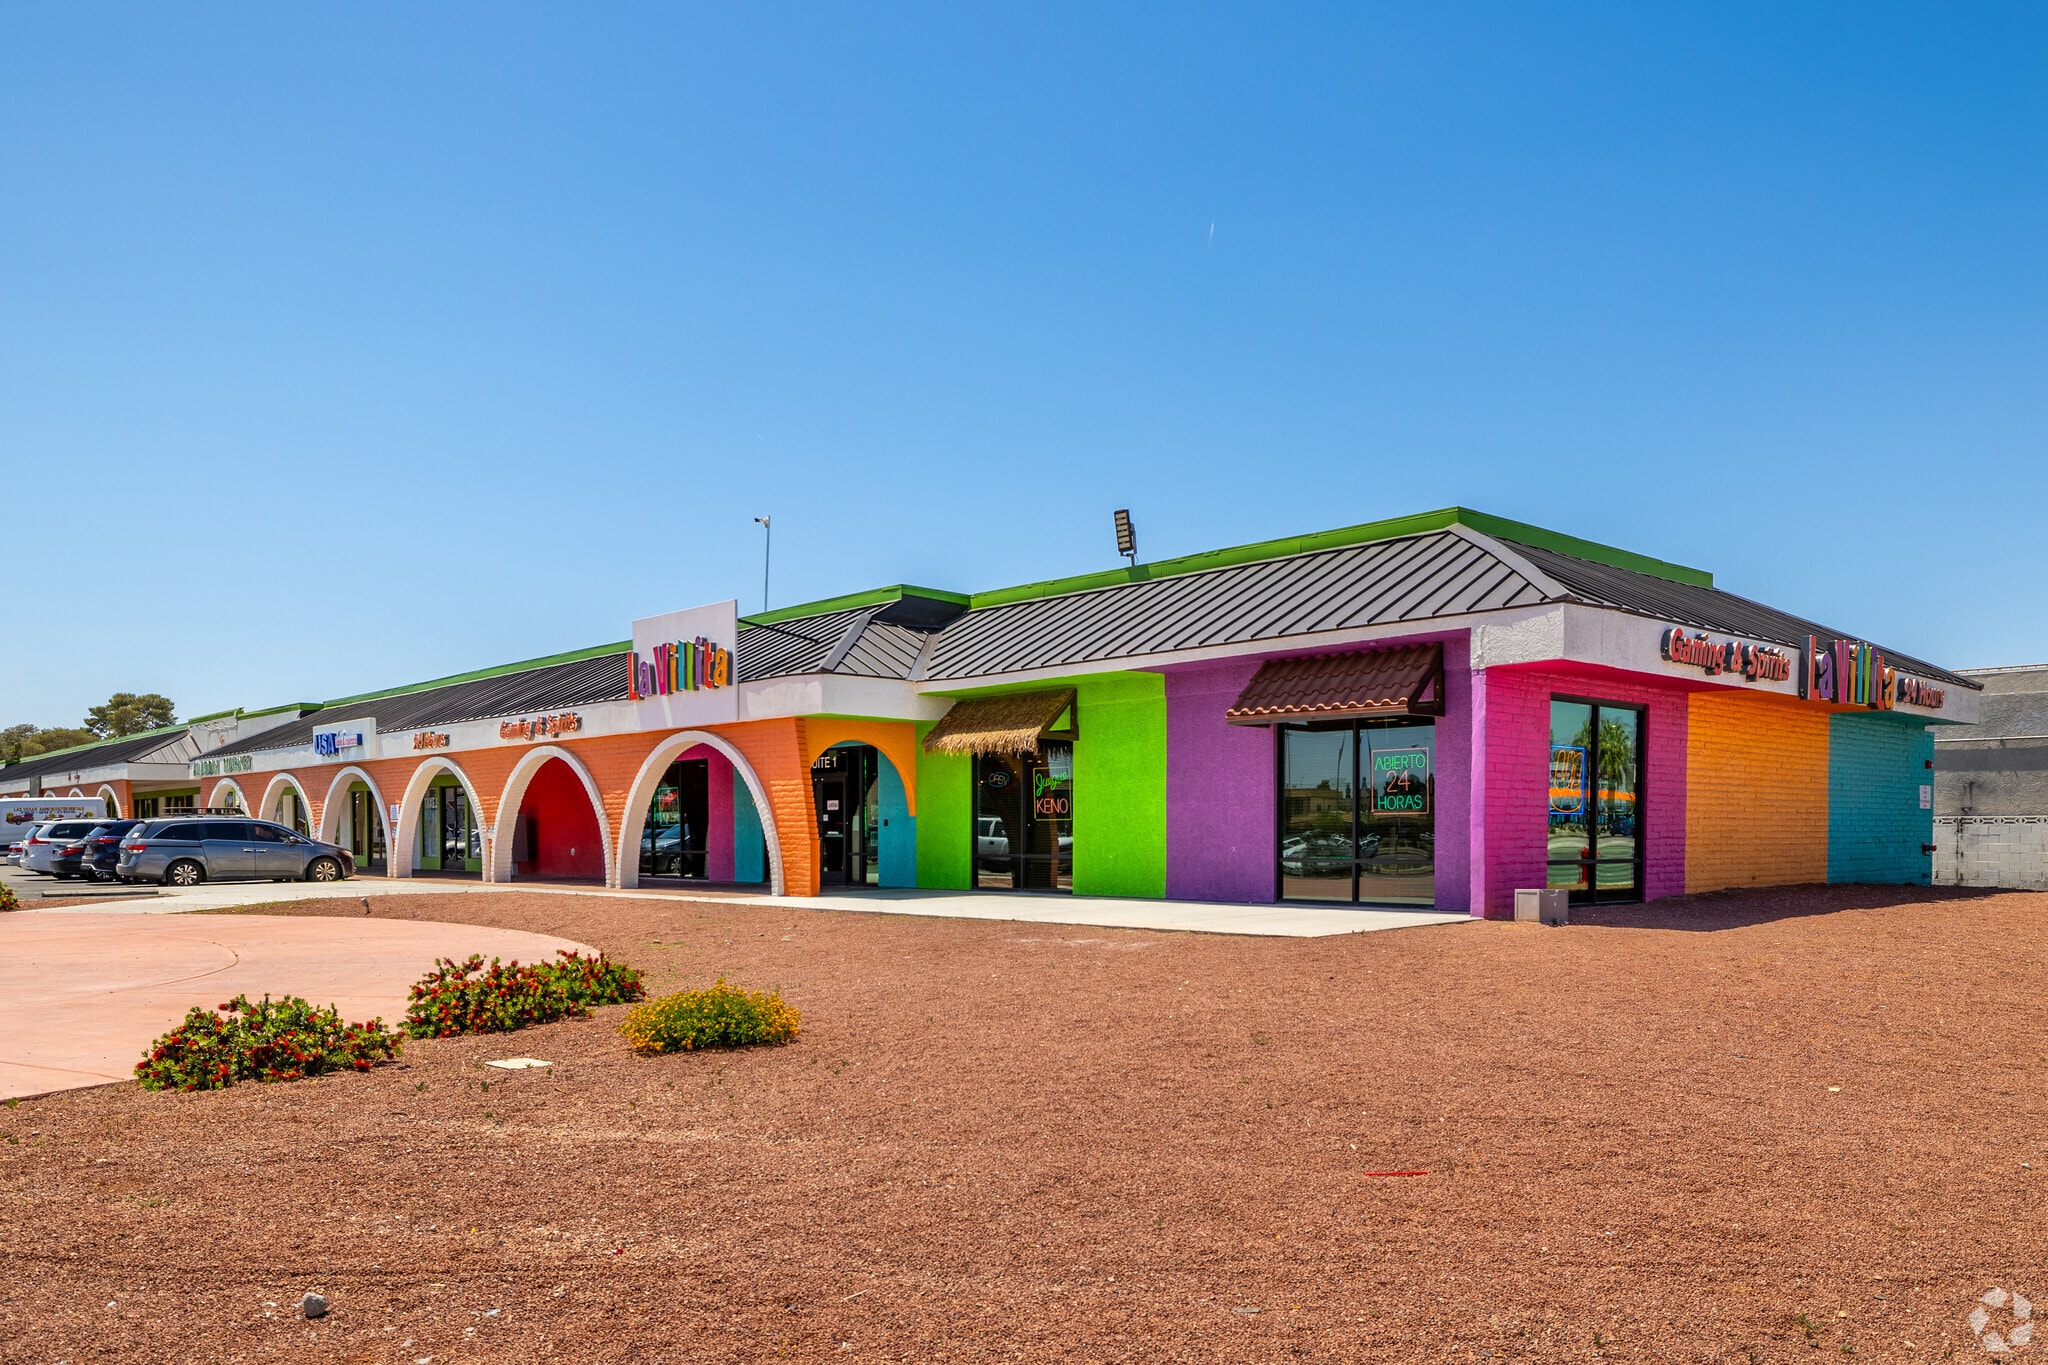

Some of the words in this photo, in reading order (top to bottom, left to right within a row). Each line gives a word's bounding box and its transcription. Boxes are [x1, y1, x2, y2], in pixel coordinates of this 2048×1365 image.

[1667, 627, 1727, 676] Gaming
[1731, 640, 1743, 672] &
[1747, 643, 1791, 683] Spirits
[1903, 677, 1919, 704] 24
[1919, 680, 1946, 709] Hours
[499, 718, 531, 741] Gaming
[545, 712, 578, 738] Spirits
[313, 733, 336, 756] USA
[422, 730, 446, 749] Hours
[811, 756, 831, 769] UITE
[832, 755, 838, 768] 1
[1374, 754, 1426, 771] ABIERTO
[989, 773, 1010, 786] OPEN
[1386, 769, 1411, 793] 24
[1036, 797, 1069, 814] KENO
[1377, 794, 1423, 810] HORAS
